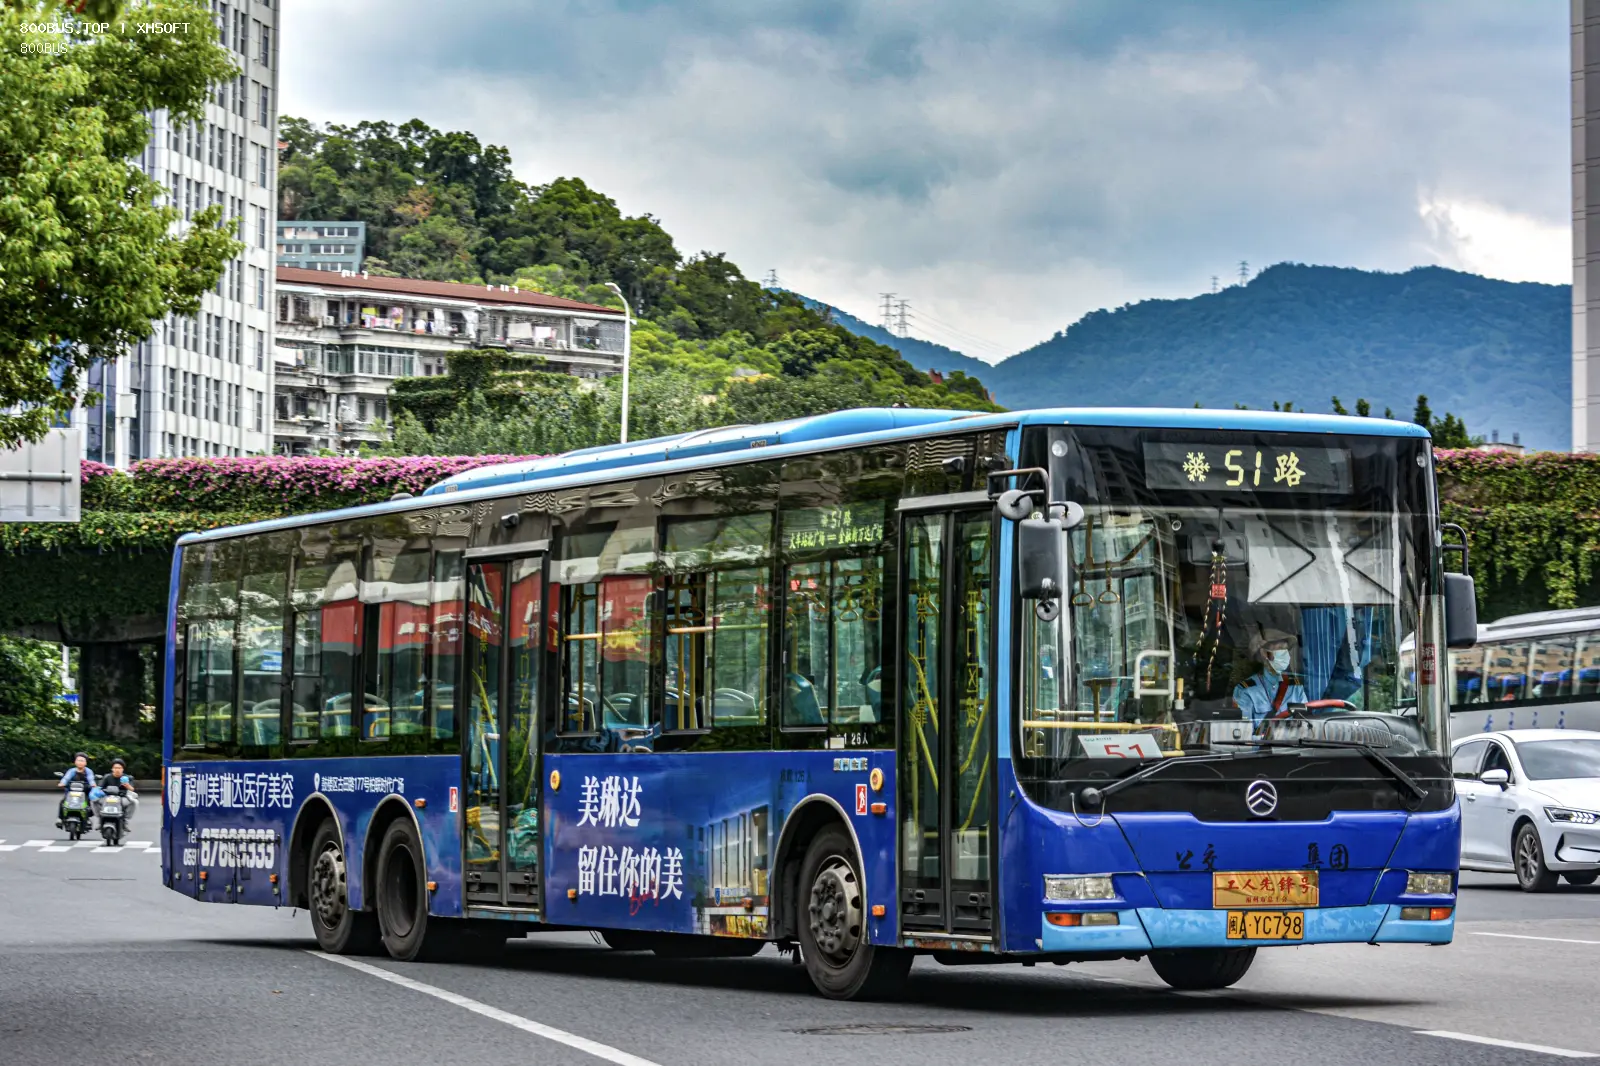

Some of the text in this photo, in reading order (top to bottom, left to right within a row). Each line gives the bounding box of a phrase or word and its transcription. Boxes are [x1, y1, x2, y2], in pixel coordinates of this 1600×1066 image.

[184, 772, 294, 808] 福州美琳达医疗美容
[576, 776, 643, 827] 美琳达
[578, 844, 684, 900] 留住你的美
[1225, 876, 1310, 894] 工人先锋号
